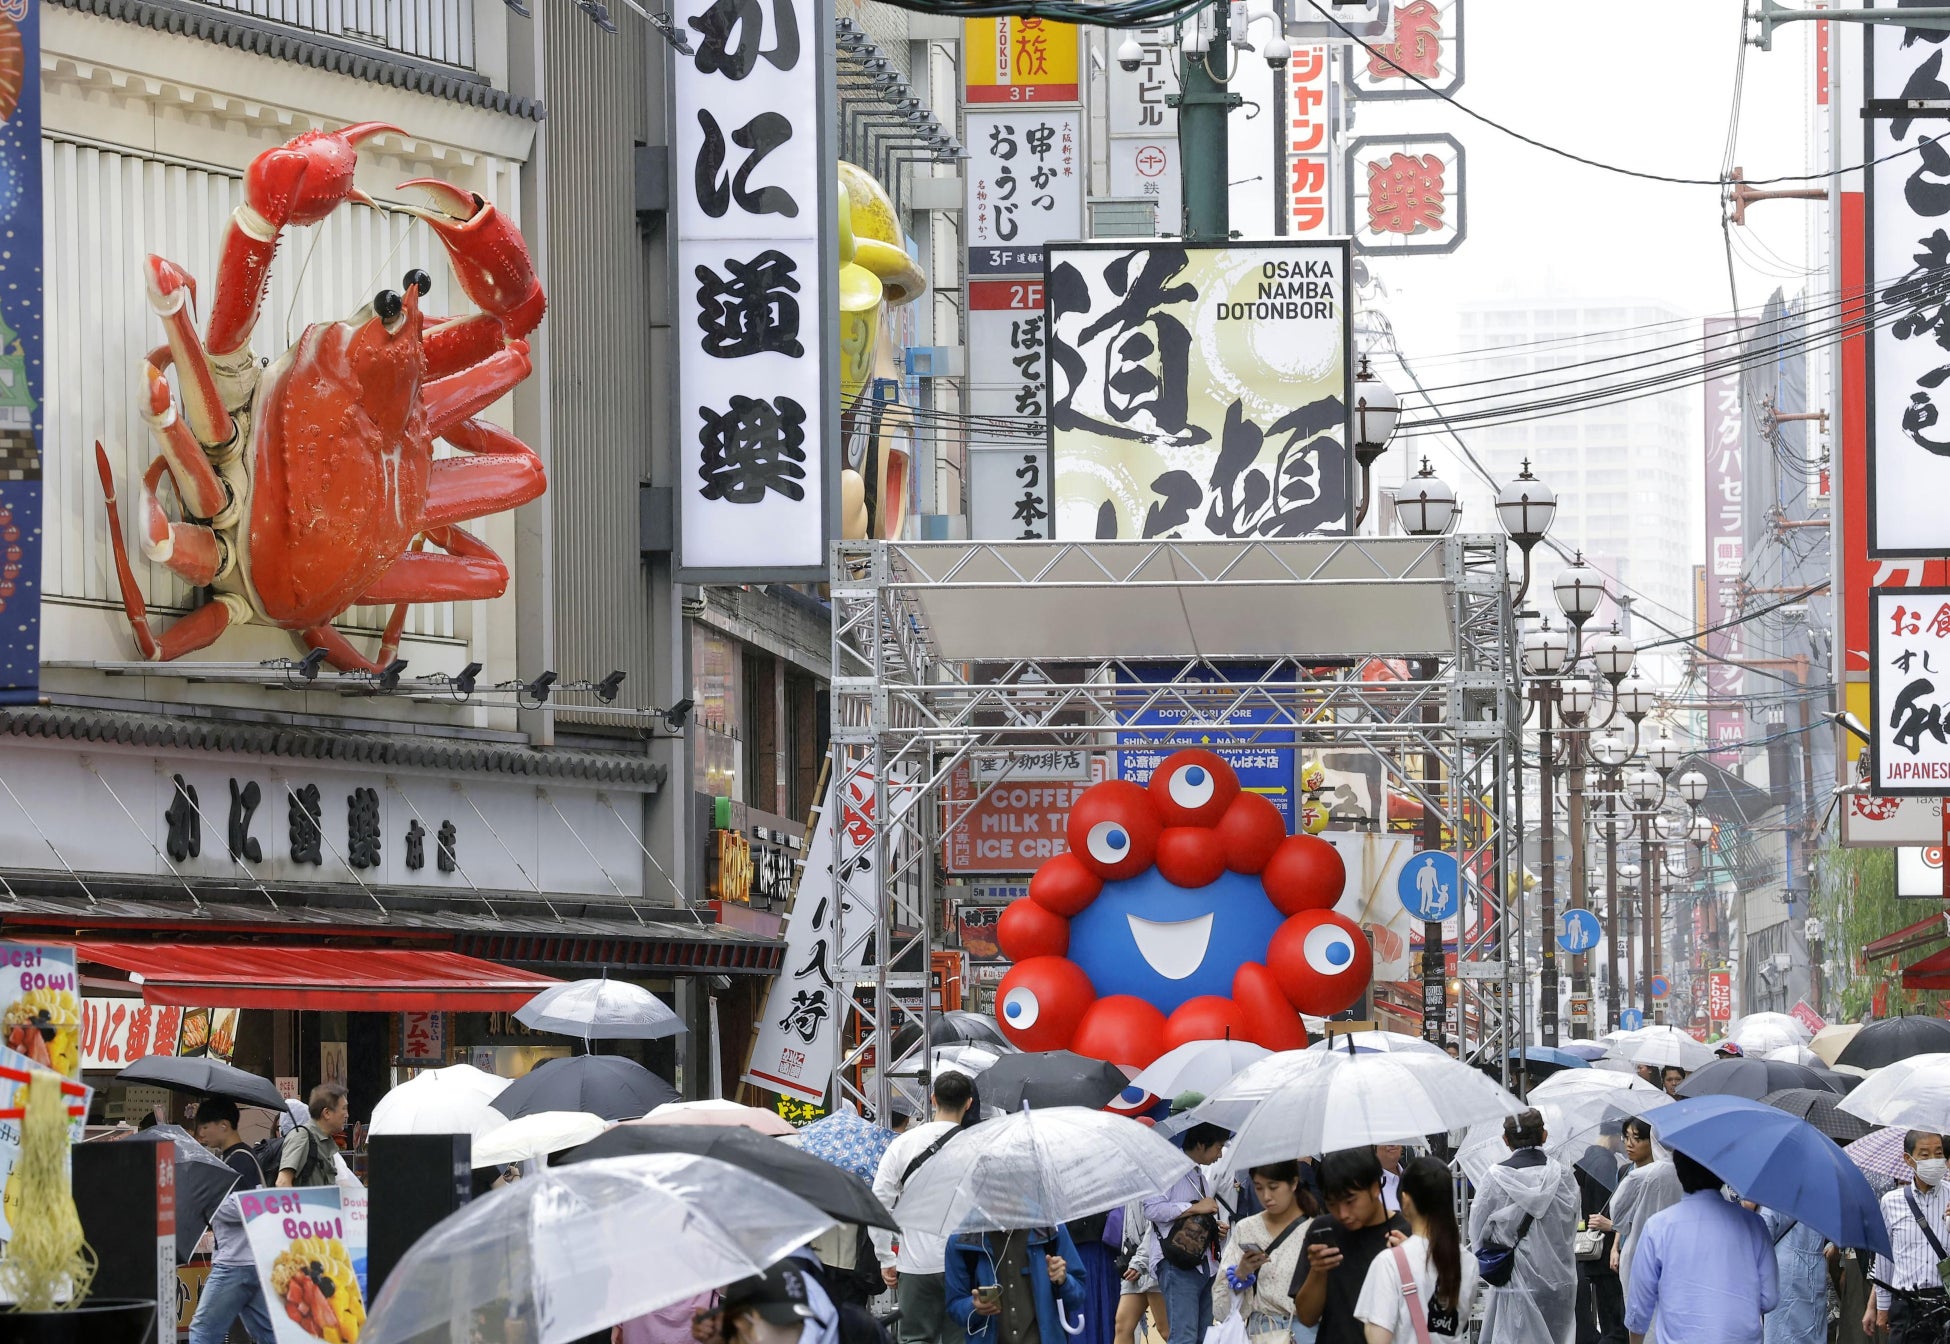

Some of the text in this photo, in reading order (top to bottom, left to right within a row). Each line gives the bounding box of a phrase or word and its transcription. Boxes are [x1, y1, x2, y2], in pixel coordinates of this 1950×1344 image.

[1292, 47, 1324, 231] ジャンカラ
[1062, 121, 1073, 177] 大阪新世界
[1025, 122, 1058, 211] 串かつ
[989, 124, 1018, 242] おうじ
[977, 179, 988, 241] 名物の串かつ
[989, 251, 1013, 266] 3F
[1262, 261, 1333, 279] OSAKA
[1010, 285, 1043, 308] 2F
[1257, 282, 1333, 300] NAMBA
[1216, 302, 1333, 321] DOTONBORI
[1222, 755, 1279, 769] んば本店
[981, 813, 1040, 833] MILK
[976, 838, 1071, 859] ICE CRE
[964, 910, 1002, 927] 神戸
[777, 1101, 825, 1119] ドンキー
[343, 1197, 368, 1207] Doub
